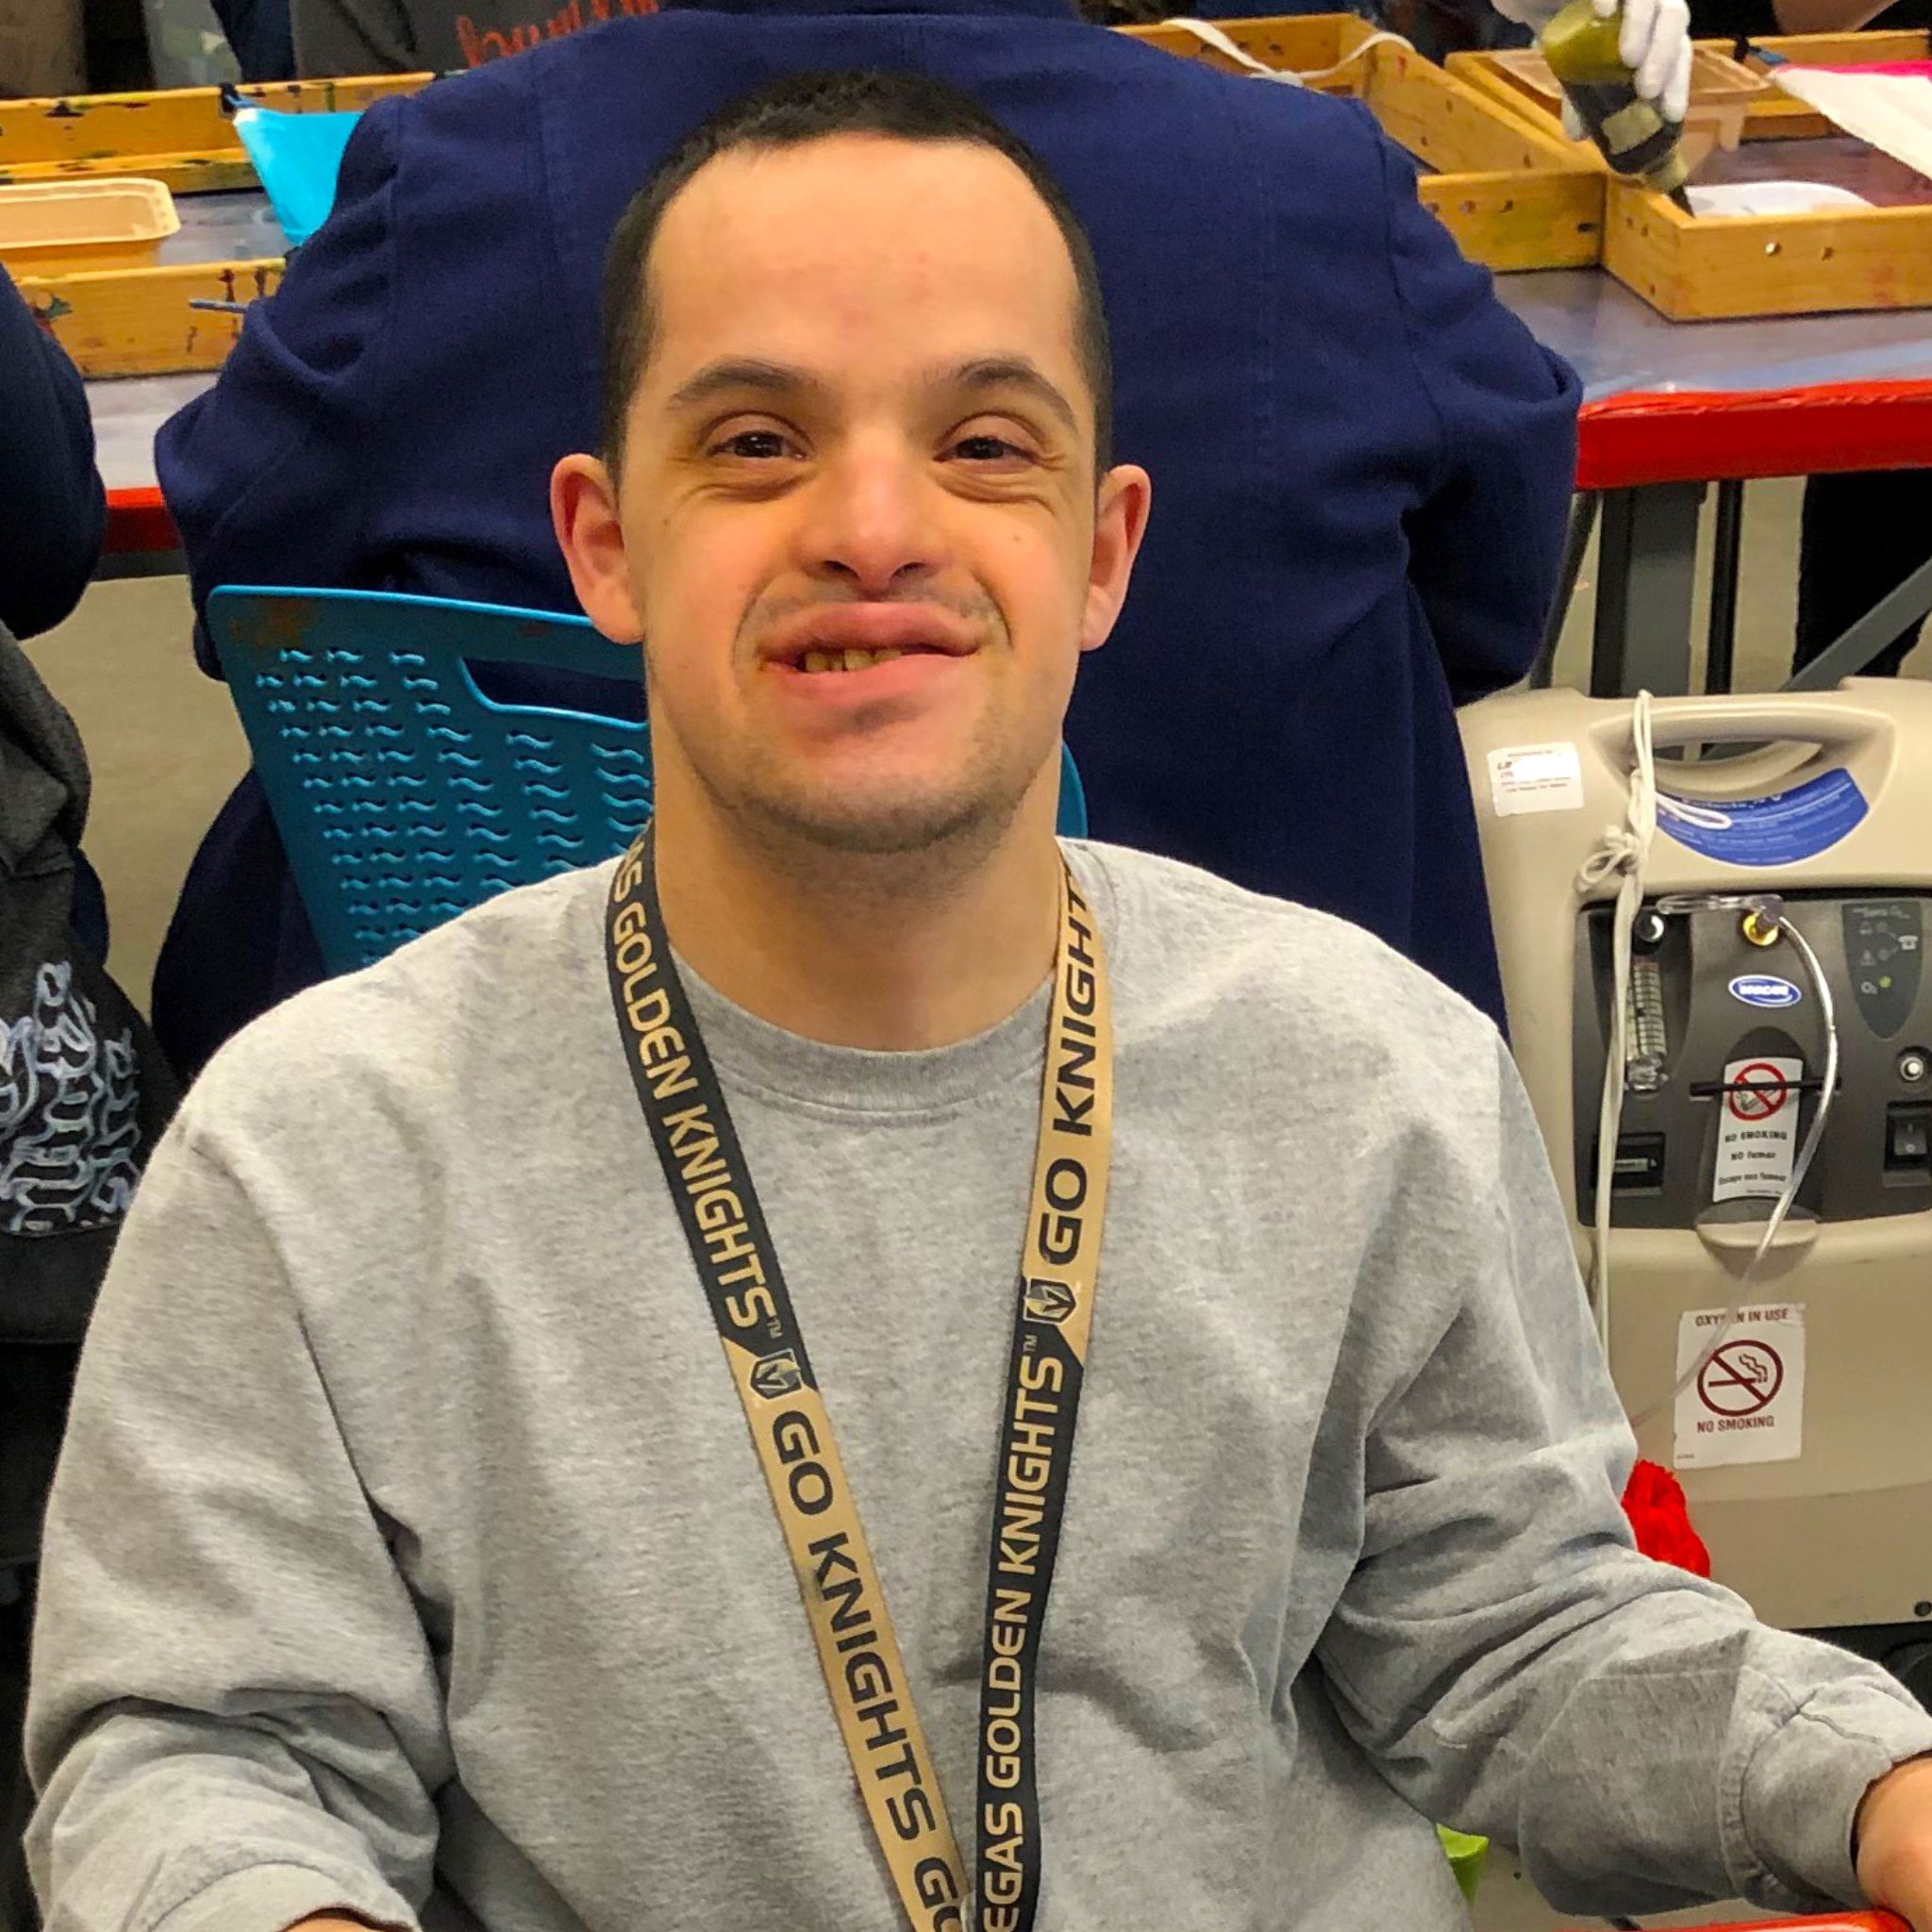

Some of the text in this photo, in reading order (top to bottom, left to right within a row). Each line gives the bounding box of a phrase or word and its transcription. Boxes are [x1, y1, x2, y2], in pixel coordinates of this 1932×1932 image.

[613, 902, 699, 1100] GOLDEN
[663, 1104, 777, 1328] KNIGHTS
[1038, 1158, 1088, 1266] GO
[1748, 1309, 1762, 1322] IN
[1765, 1307, 1789, 1322] USE
[998, 1355, 1064, 1575] KNIGHTS
[1696, 1415, 1775, 1433] NO SMOKING
[772, 1409, 834, 1516] GO
[808, 1532, 938, 1841] KNIGHTS
[985, 1590, 1031, 1791] GOLDEN
